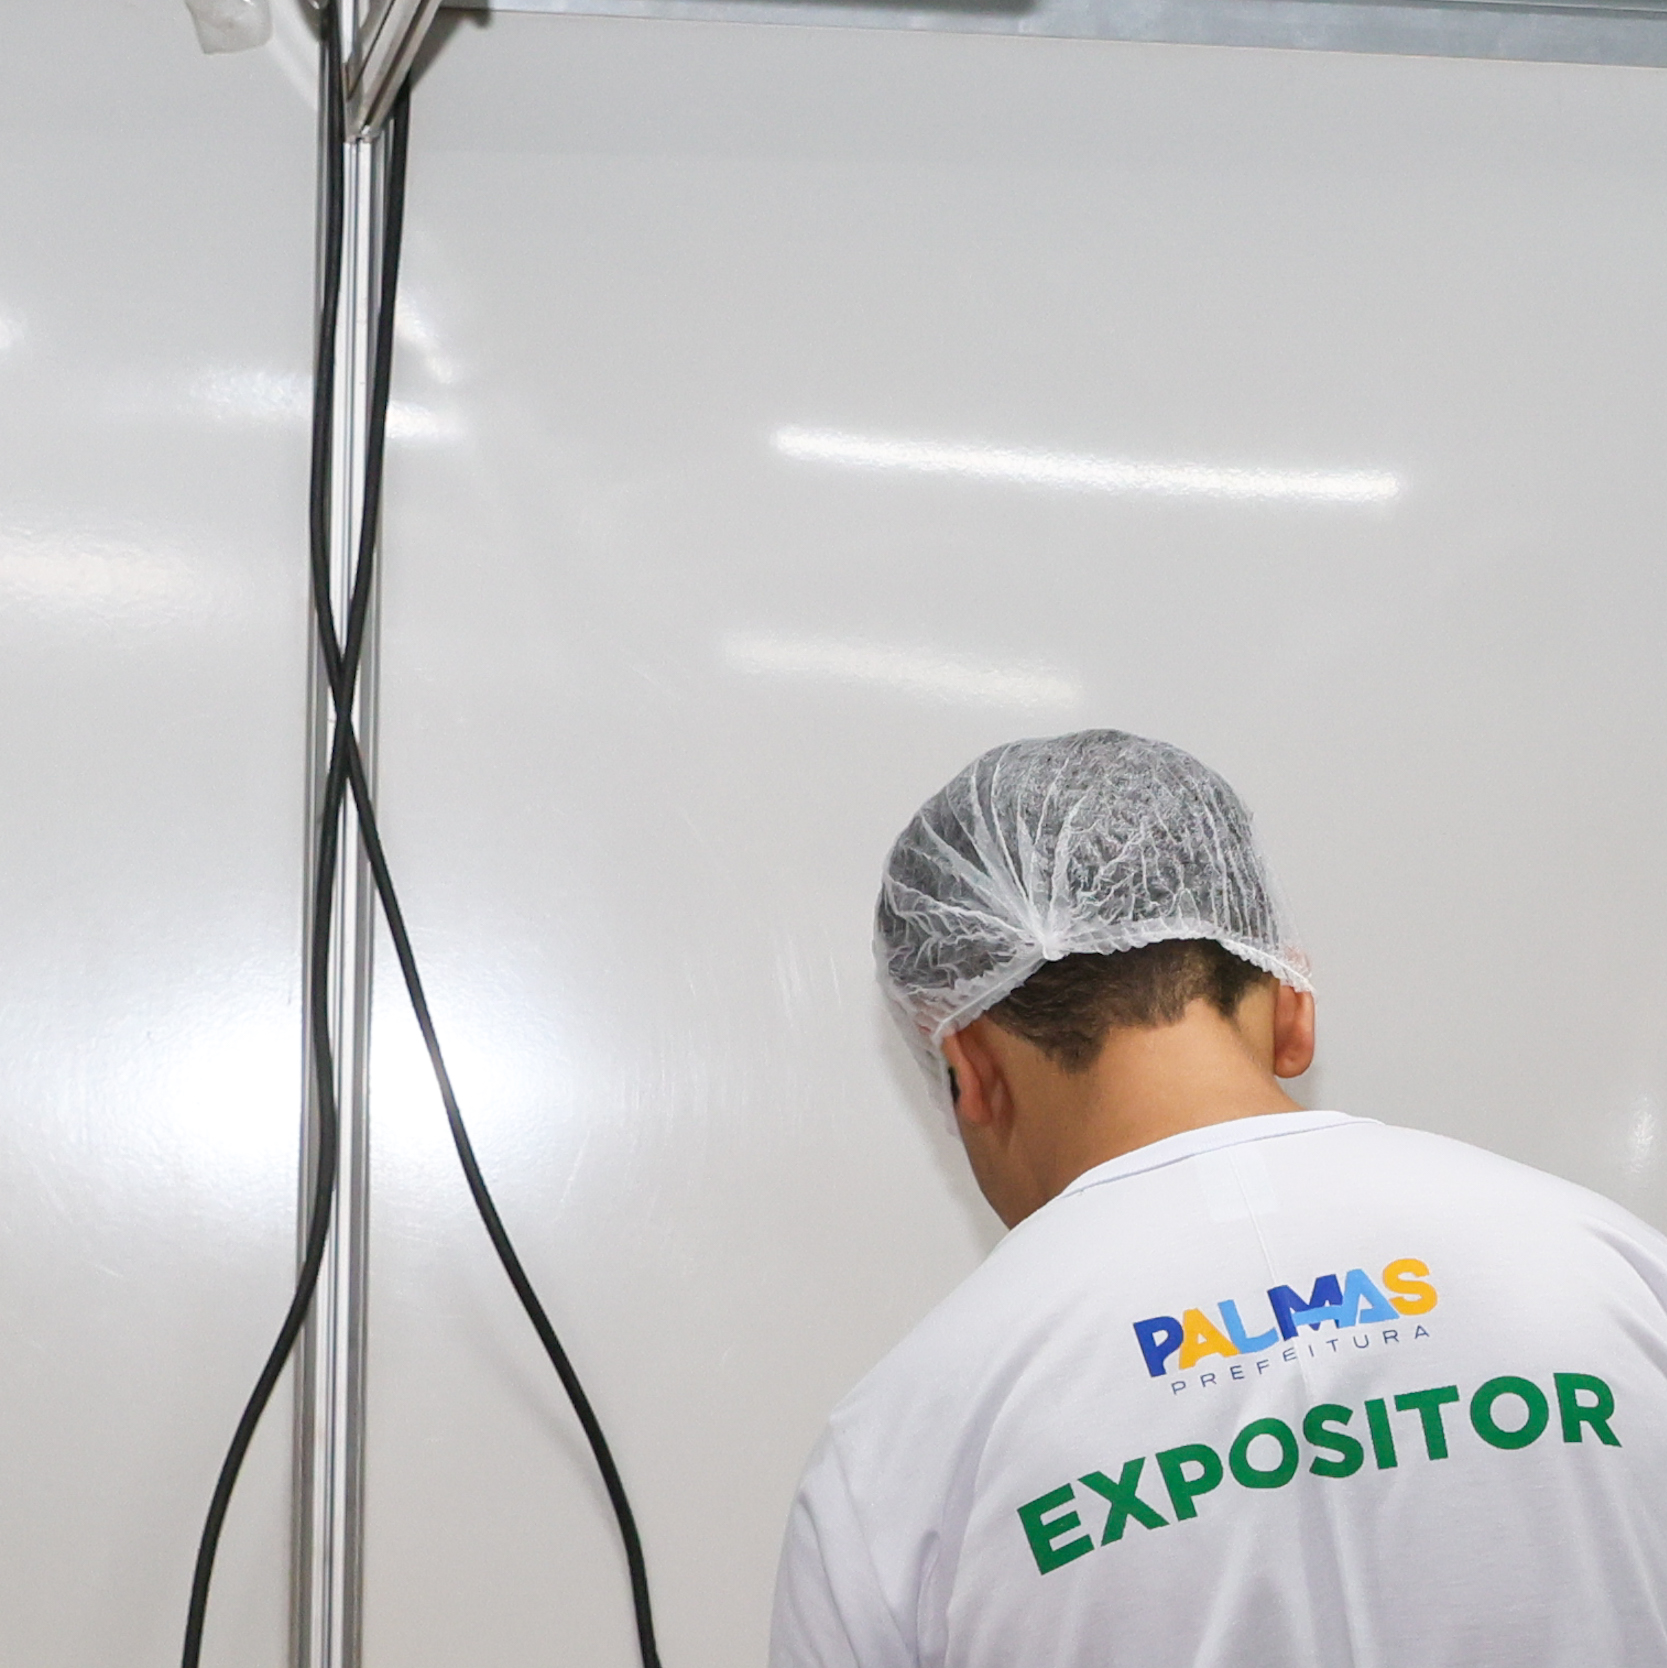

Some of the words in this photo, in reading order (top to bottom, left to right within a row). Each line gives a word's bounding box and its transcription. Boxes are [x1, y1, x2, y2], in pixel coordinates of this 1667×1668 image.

[1132, 1257, 1439, 1378] PALMAS
[1171, 1324, 1430, 1396] PREFEITURA
[1015, 1371, 1623, 1577] EXPOSITOR
